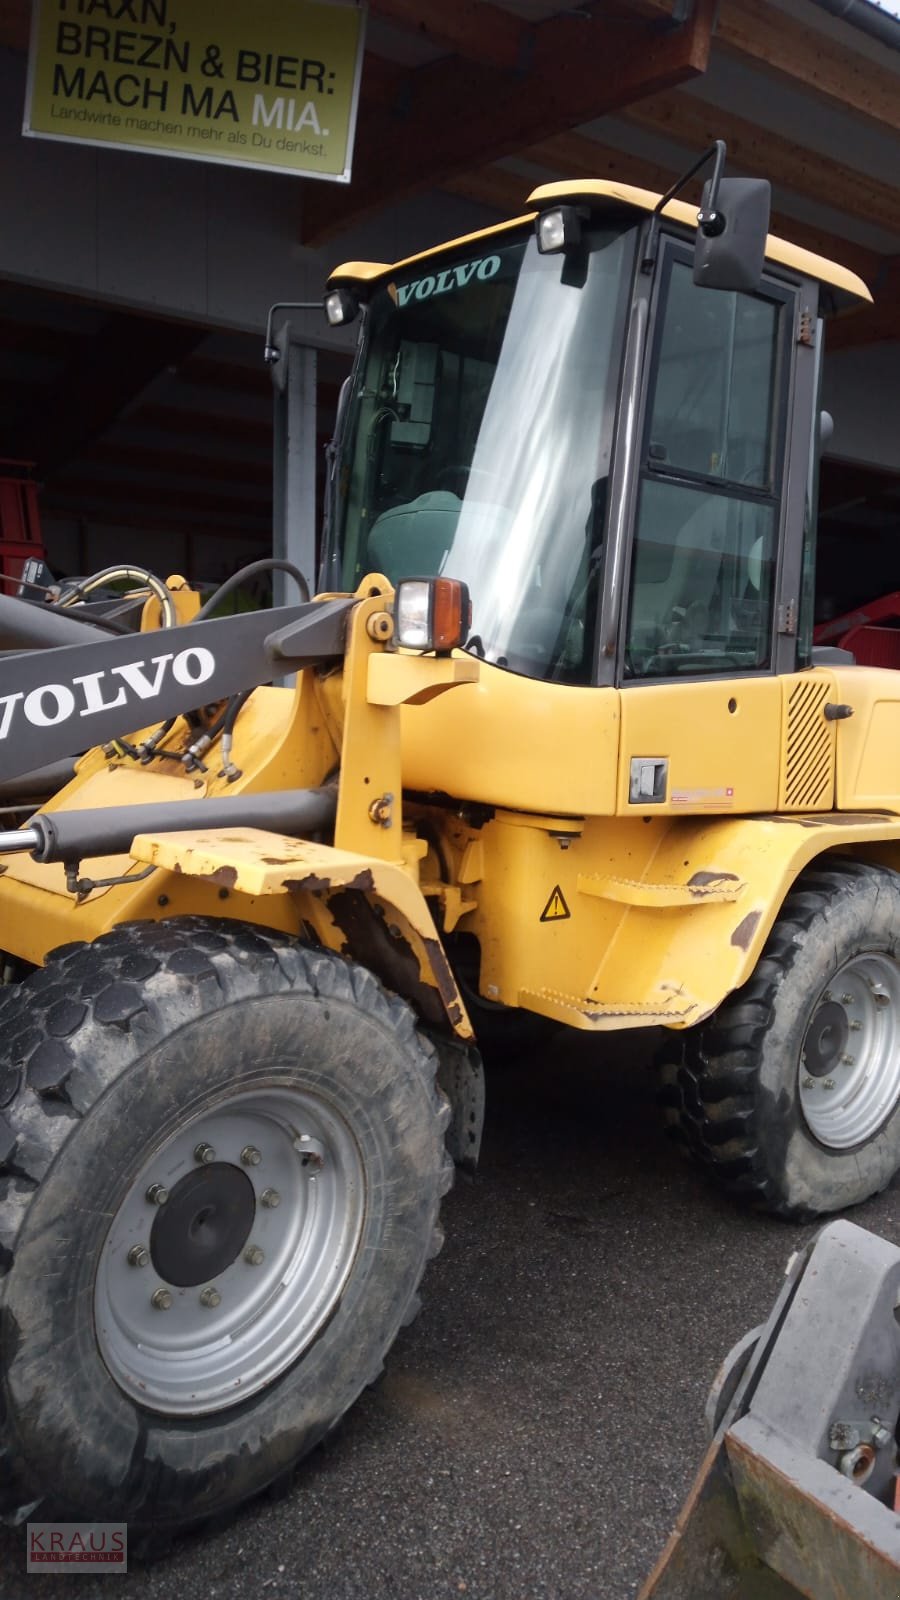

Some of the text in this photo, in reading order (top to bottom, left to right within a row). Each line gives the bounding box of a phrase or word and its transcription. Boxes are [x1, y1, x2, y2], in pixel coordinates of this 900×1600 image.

[56, 21, 336, 95] BREZN & BIER:
[50, 103, 328, 157] Landwirte machen mehr als Du denkst.
[52, 63, 330, 136] MACH MA MIA.
[396, 255, 501, 308] VOLVO
